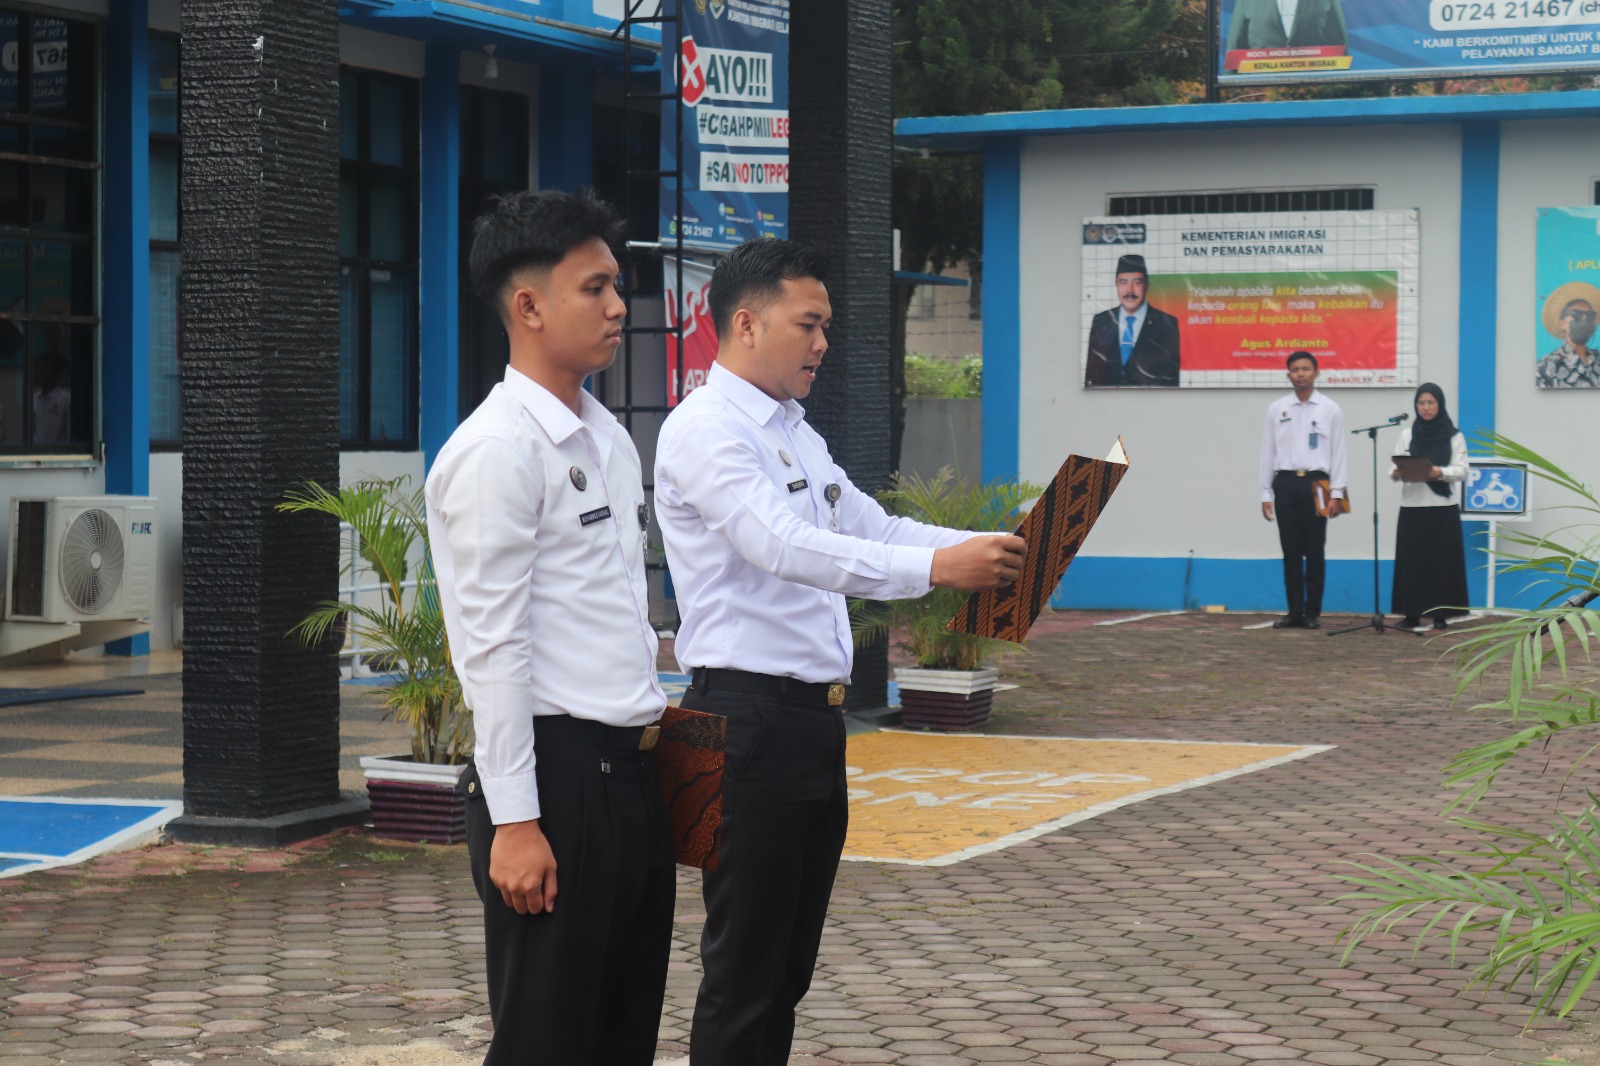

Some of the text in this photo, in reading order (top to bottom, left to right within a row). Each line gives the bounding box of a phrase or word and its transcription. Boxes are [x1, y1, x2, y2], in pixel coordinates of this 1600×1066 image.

[1442, 3, 1496, 22] 0724
[1505, 0, 1574, 19] 21467
[1423, 38, 1453, 48] KAMI
[1456, 34, 1547, 47] BERKOMITMEN
[1550, 32, 1594, 43] UNTUK
[1462, 47, 1535, 60] PELAYANAN
[1537, 44, 1588, 56] SANGAT
[1254, 62, 1278, 70] KEPALA
[706, 54, 767, 97] AYO!!!
[1181, 230, 1326, 241] KEMENTERIAN IMIGRASI
[1184, 245, 1324, 257] DAN PEMASYARAKATAN
[1236, 287, 1274, 299] apabila
[1276, 287, 1297, 296] kita
[1298, 286, 1339, 296] berbuat
[1187, 301, 1225, 312] kepada
[1227, 303, 1259, 313] orang
[1287, 301, 1315, 310] maka
[1318, 300, 1368, 310] kebaikan
[1187, 316, 1213, 325] akan
[1215, 314, 1257, 324] kembali
[1259, 314, 1299, 325] kepada
[1241, 338, 1329, 350] Agus Ardianto
[1468, 469, 1482, 488] P
[845, 765, 1152, 788] ROP
